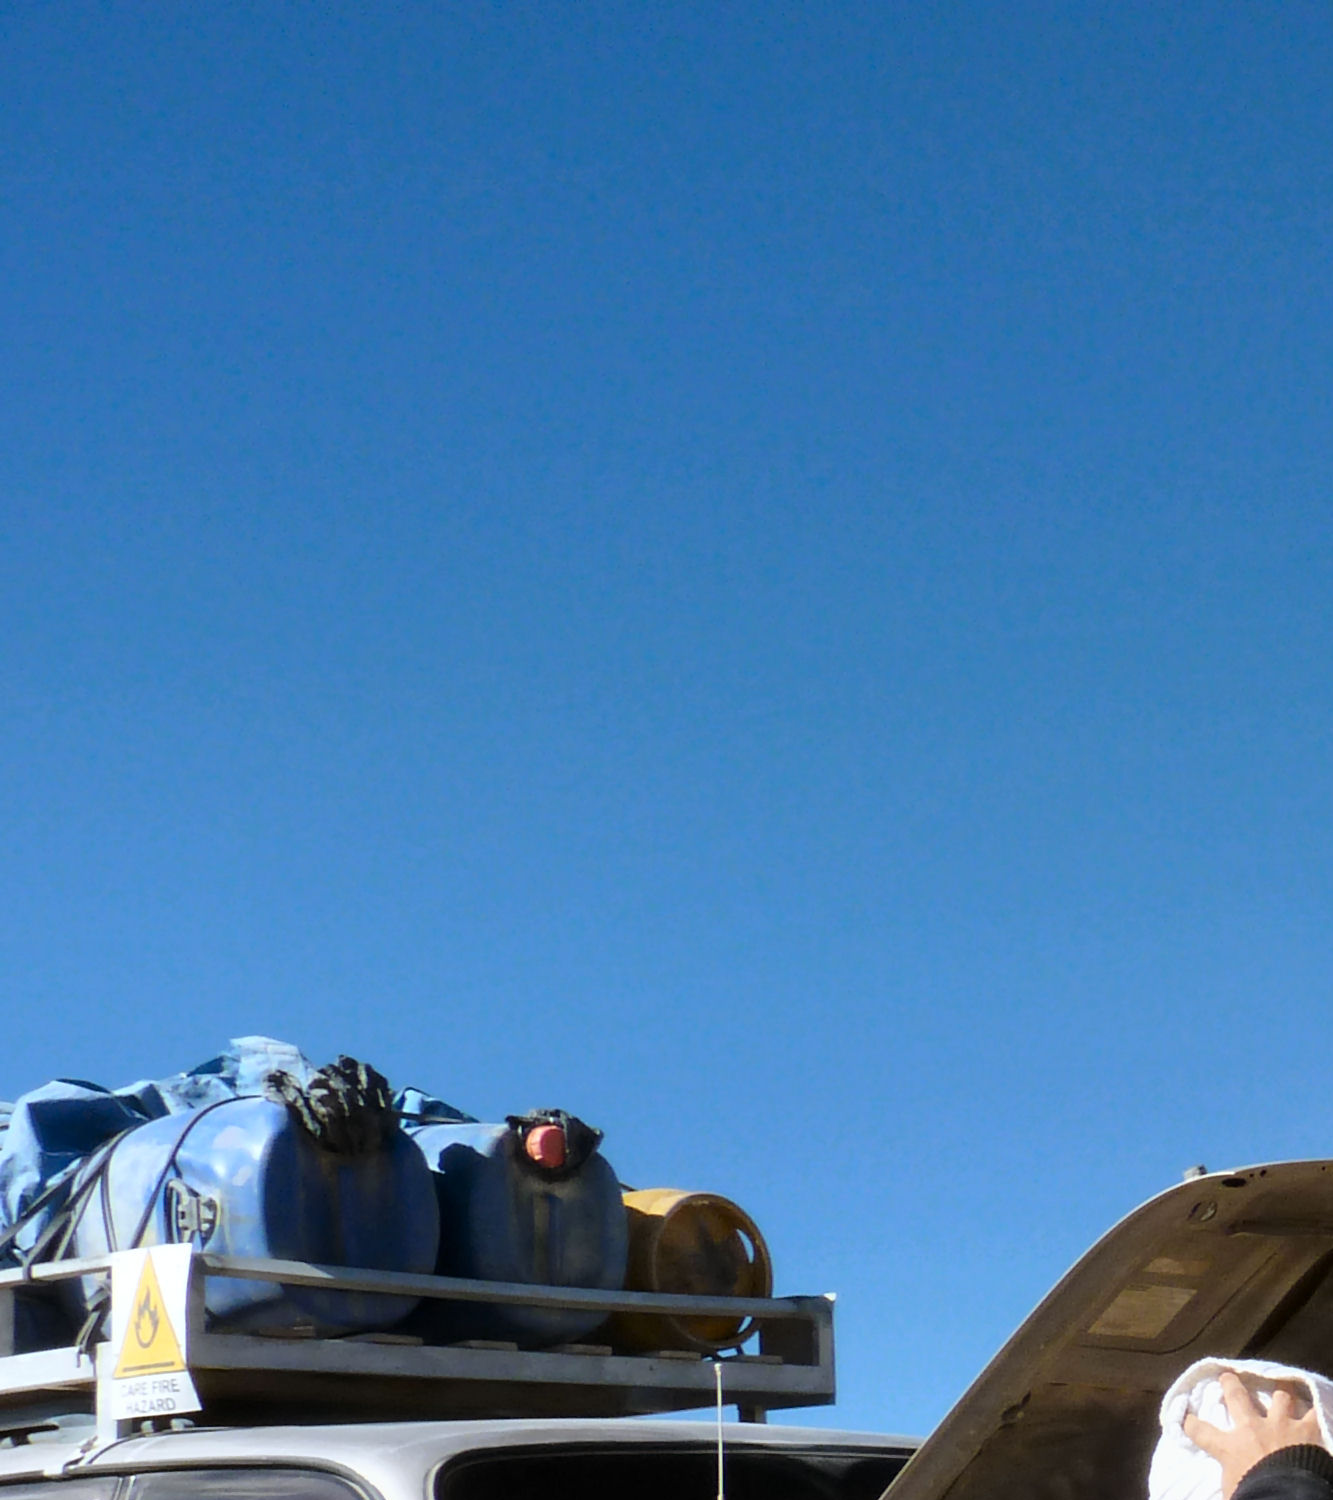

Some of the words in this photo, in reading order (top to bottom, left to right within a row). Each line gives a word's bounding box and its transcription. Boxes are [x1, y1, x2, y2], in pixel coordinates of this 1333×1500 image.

[121, 1382, 148, 1398] CARE
[151, 1378, 180, 1394] FIRE
[125, 1398, 176, 1414] HAZARD
